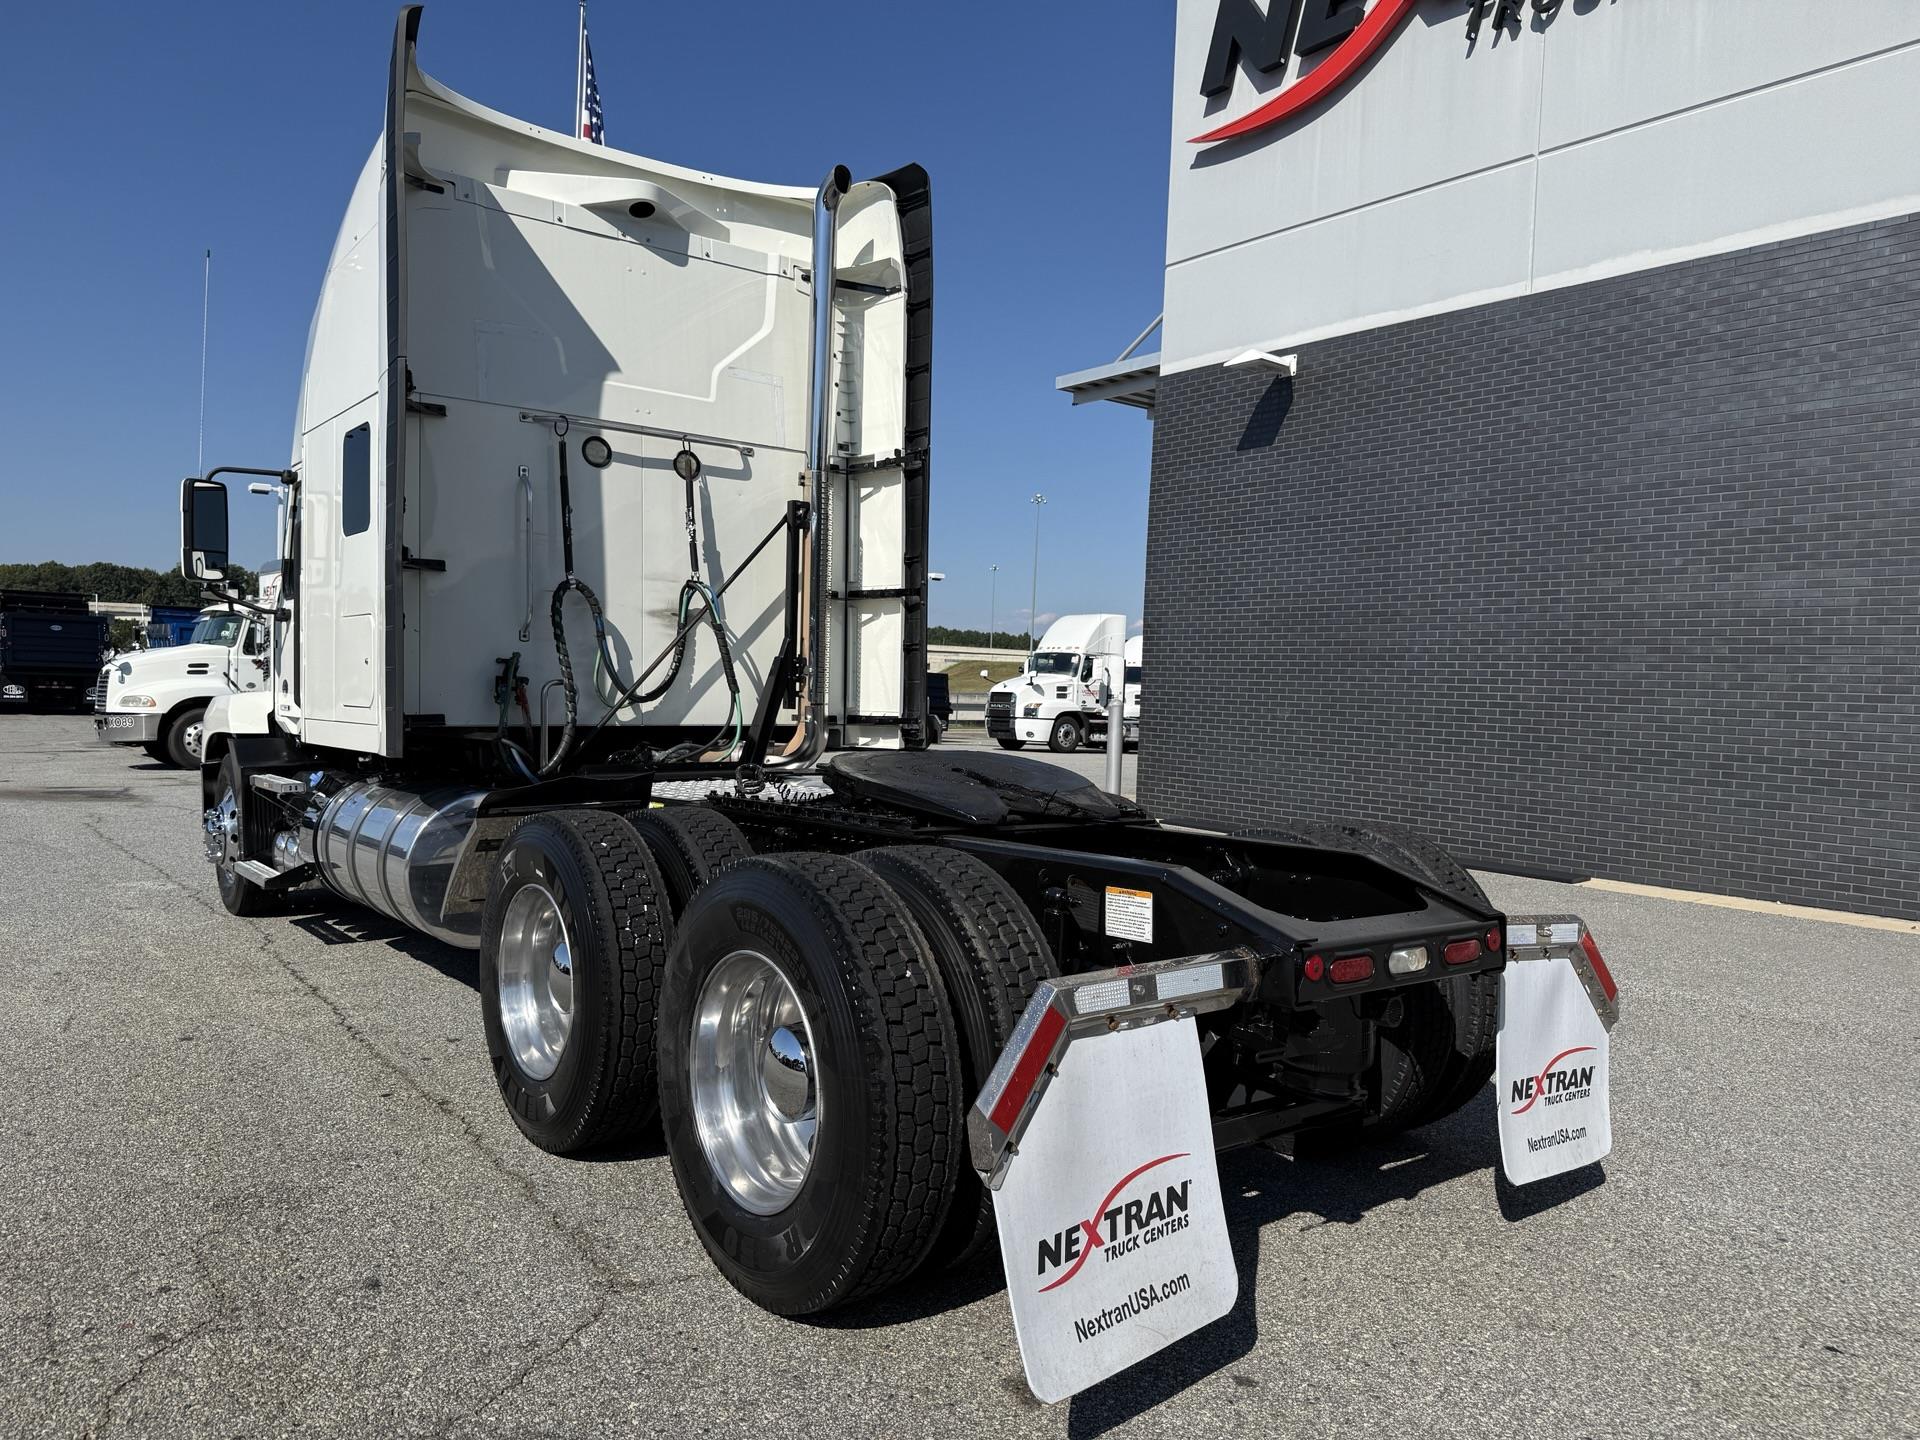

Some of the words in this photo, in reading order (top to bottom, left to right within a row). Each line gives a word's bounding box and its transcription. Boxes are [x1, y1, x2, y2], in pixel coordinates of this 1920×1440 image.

[1511, 1066, 1594, 1103] NEXTRAN
[1544, 1094, 1563, 1107] TRUCK
[1564, 1088, 1591, 1101] CENTERS
[1527, 1127, 1587, 1153] NextranUSA.com
[1037, 1179, 1190, 1276] NEXTRAN
[1104, 1233, 1140, 1263] TRUCK
[1143, 1214, 1189, 1245] CENTERS
[1074, 1273, 1190, 1343] NextranUSA.com
